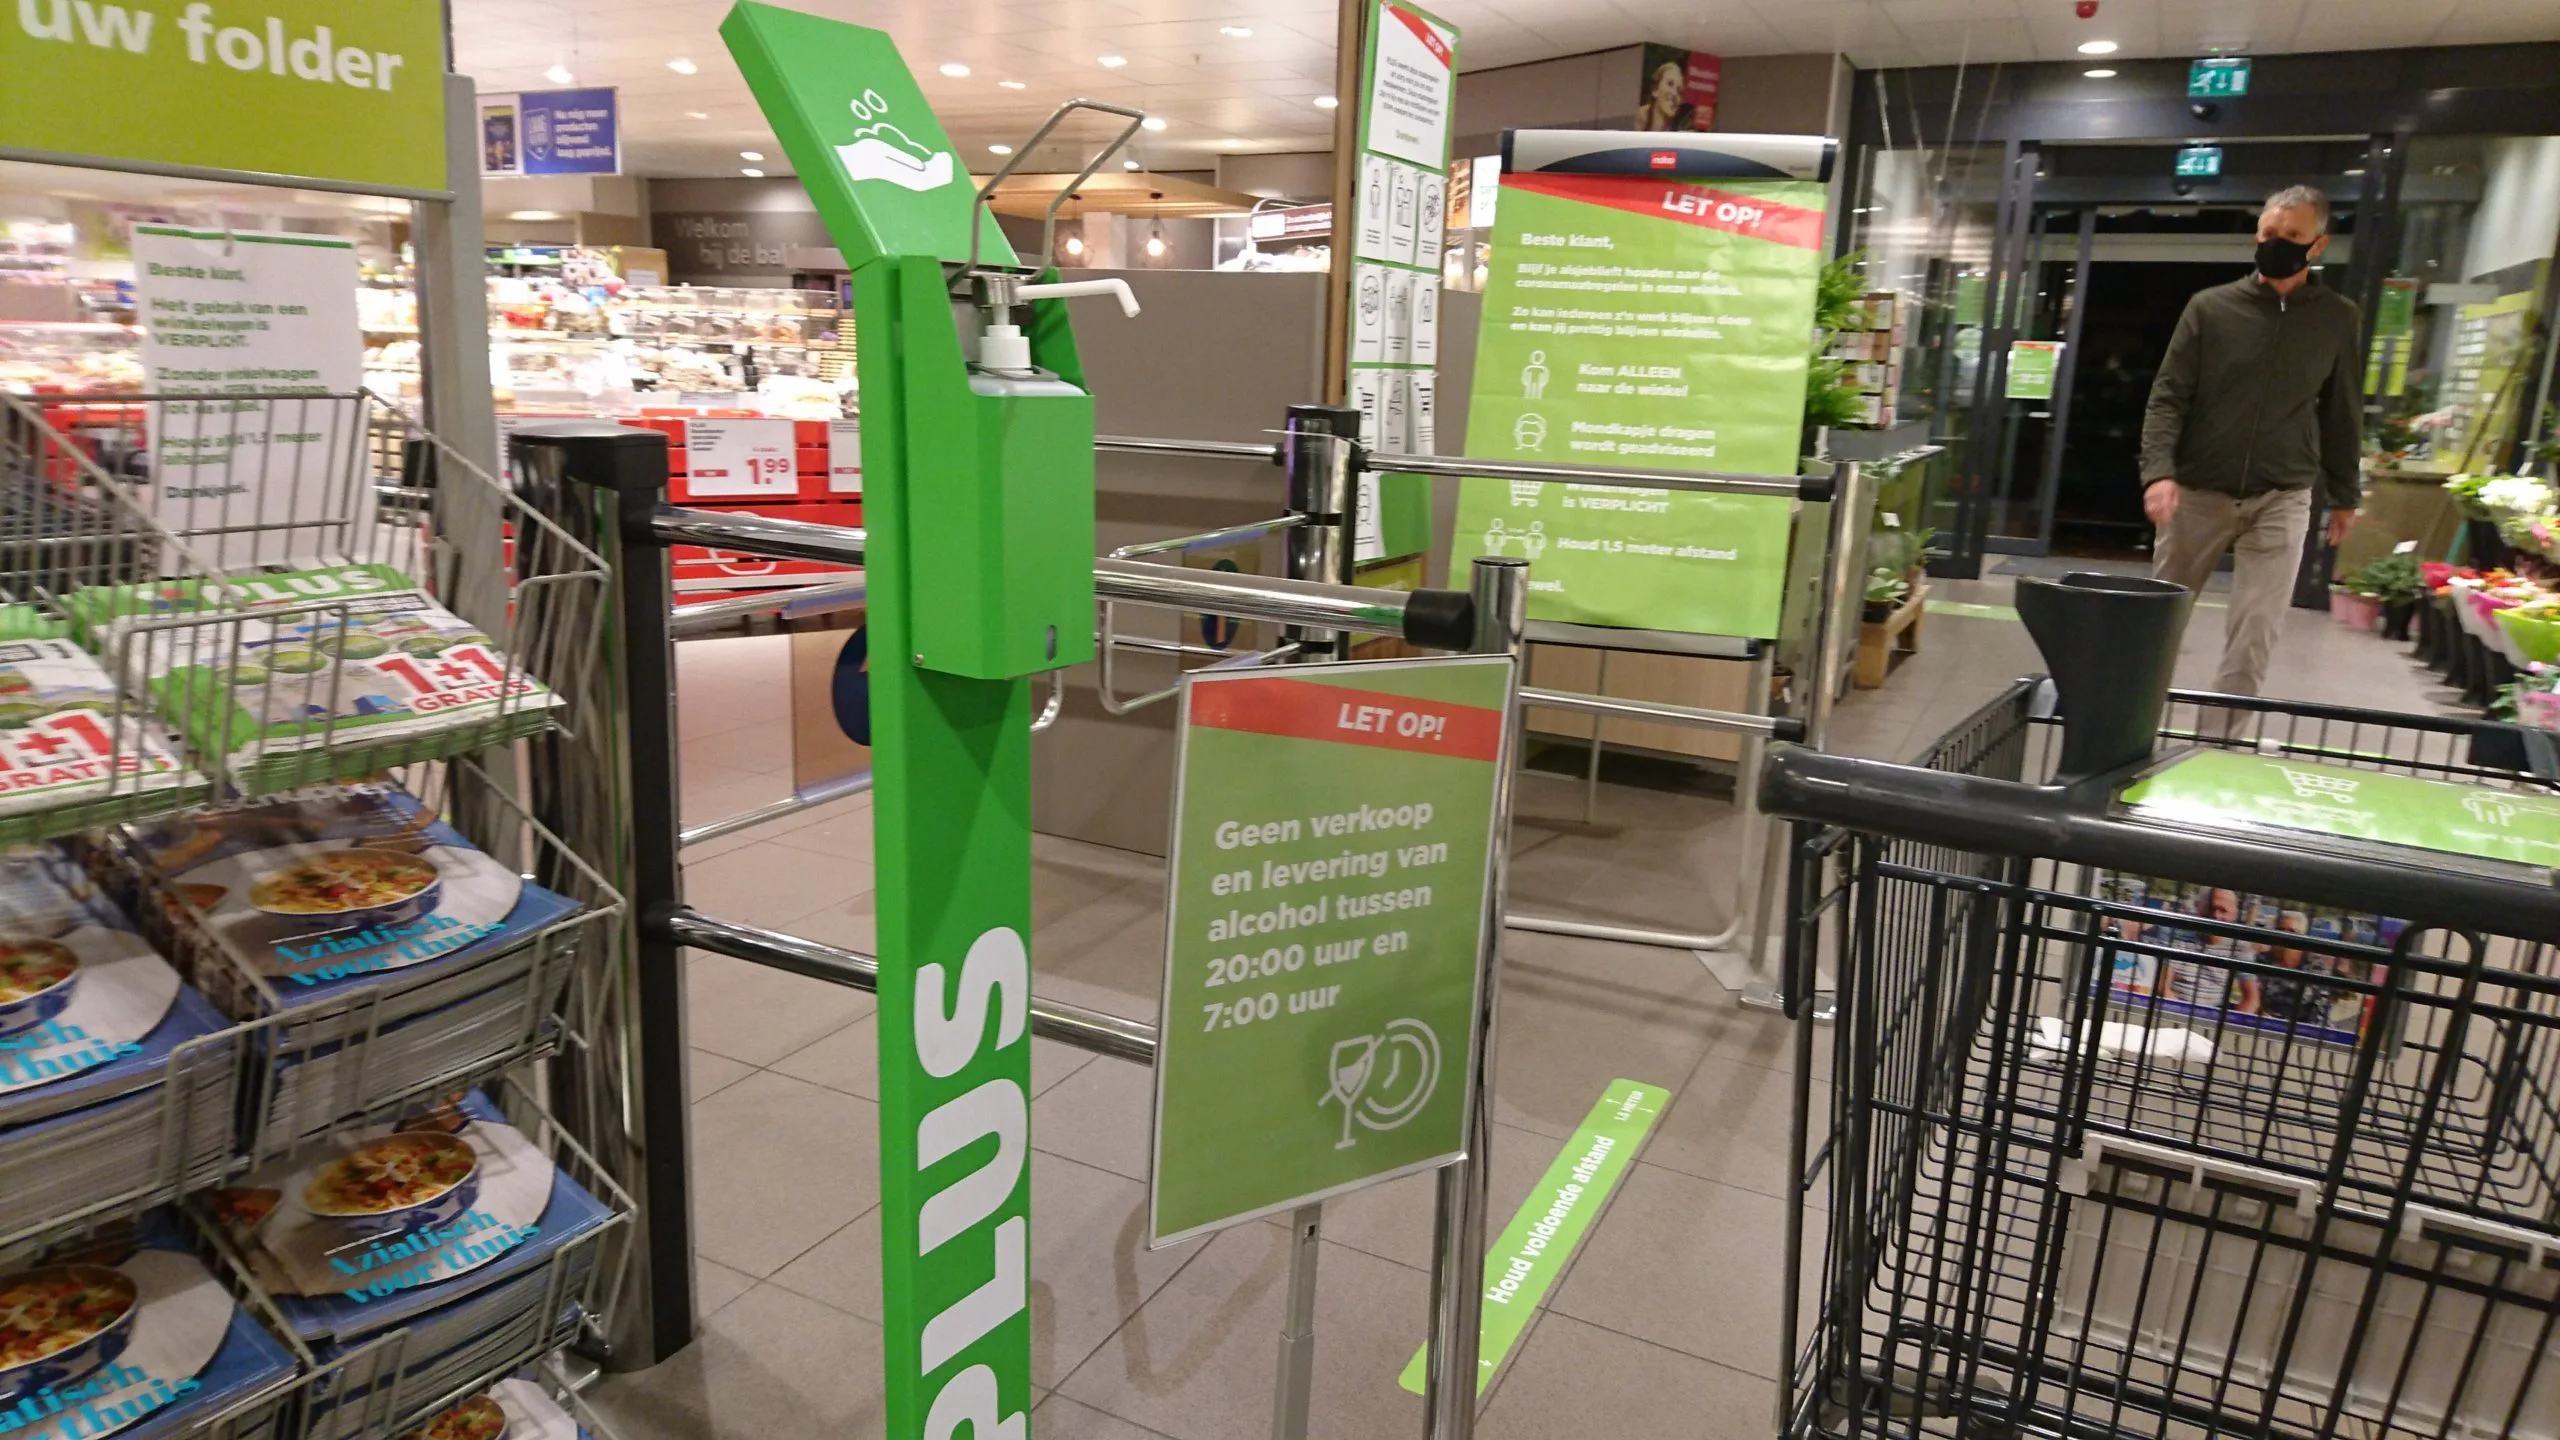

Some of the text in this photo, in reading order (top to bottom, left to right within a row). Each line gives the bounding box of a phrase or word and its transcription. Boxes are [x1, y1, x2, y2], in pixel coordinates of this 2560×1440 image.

[18, 0, 404, 91] uw folder
[674, 217, 749, 238] Welkom
[1662, 191, 1764, 228] LET OP!
[728, 243, 751, 264] de
[1521, 233, 1615, 250] Beste klant,
[148, 262, 205, 278] Beste
[1544, 264, 1557, 275] je
[1675, 271, 1700, 279] aan
[1640, 281, 1654, 292] in
[152, 298, 187, 312] Het
[278, 305, 308, 315] een
[1512, 306, 1529, 316] Zo
[1531, 307, 1555, 318] kan
[1556, 308, 1613, 320] iedereen
[1510, 322, 1527, 331] en
[1528, 321, 1552, 332] kan
[1567, 325, 1613, 336] prettig
[1576, 381, 1689, 397] naar de winkel
[1578, 362, 1681, 379] Kom ALLEEN
[1569, 440, 1716, 458] wordt geadviseerd
[1571, 421, 1716, 441] Mondkapje dragen
[1562, 496, 1670, 514] is VERPLICHT
[1556, 537, 1738, 561] Houd 1,5 meter afstand
[201, 570, 387, 605] PLUS
[375, 647, 504, 694] 1+1
[1337, 703, 1447, 741] LET OP!
[1214, 802, 1434, 850] Geen verkoop
[1211, 842, 1449, 896] en levering van
[1207, 884, 1432, 943] alcohol tussen
[276, 913, 461, 963] Aziatisch
[289, 921, 508, 986] voor thuis
[1204, 929, 1409, 988] 20:00 uur en
[1202, 983, 1341, 1033] 7:00 uur
[914, 927, 1028, 1440] PLUS
[1486, 1134, 1616, 1304] Houd voldoende afstand
[330, 1209, 500, 1276] Aziatisch
[345, 1223, 541, 1303] voor thuis
[0, 1363, 146, 1434] atisch
[57, 1378, 202, 1440] thuis
